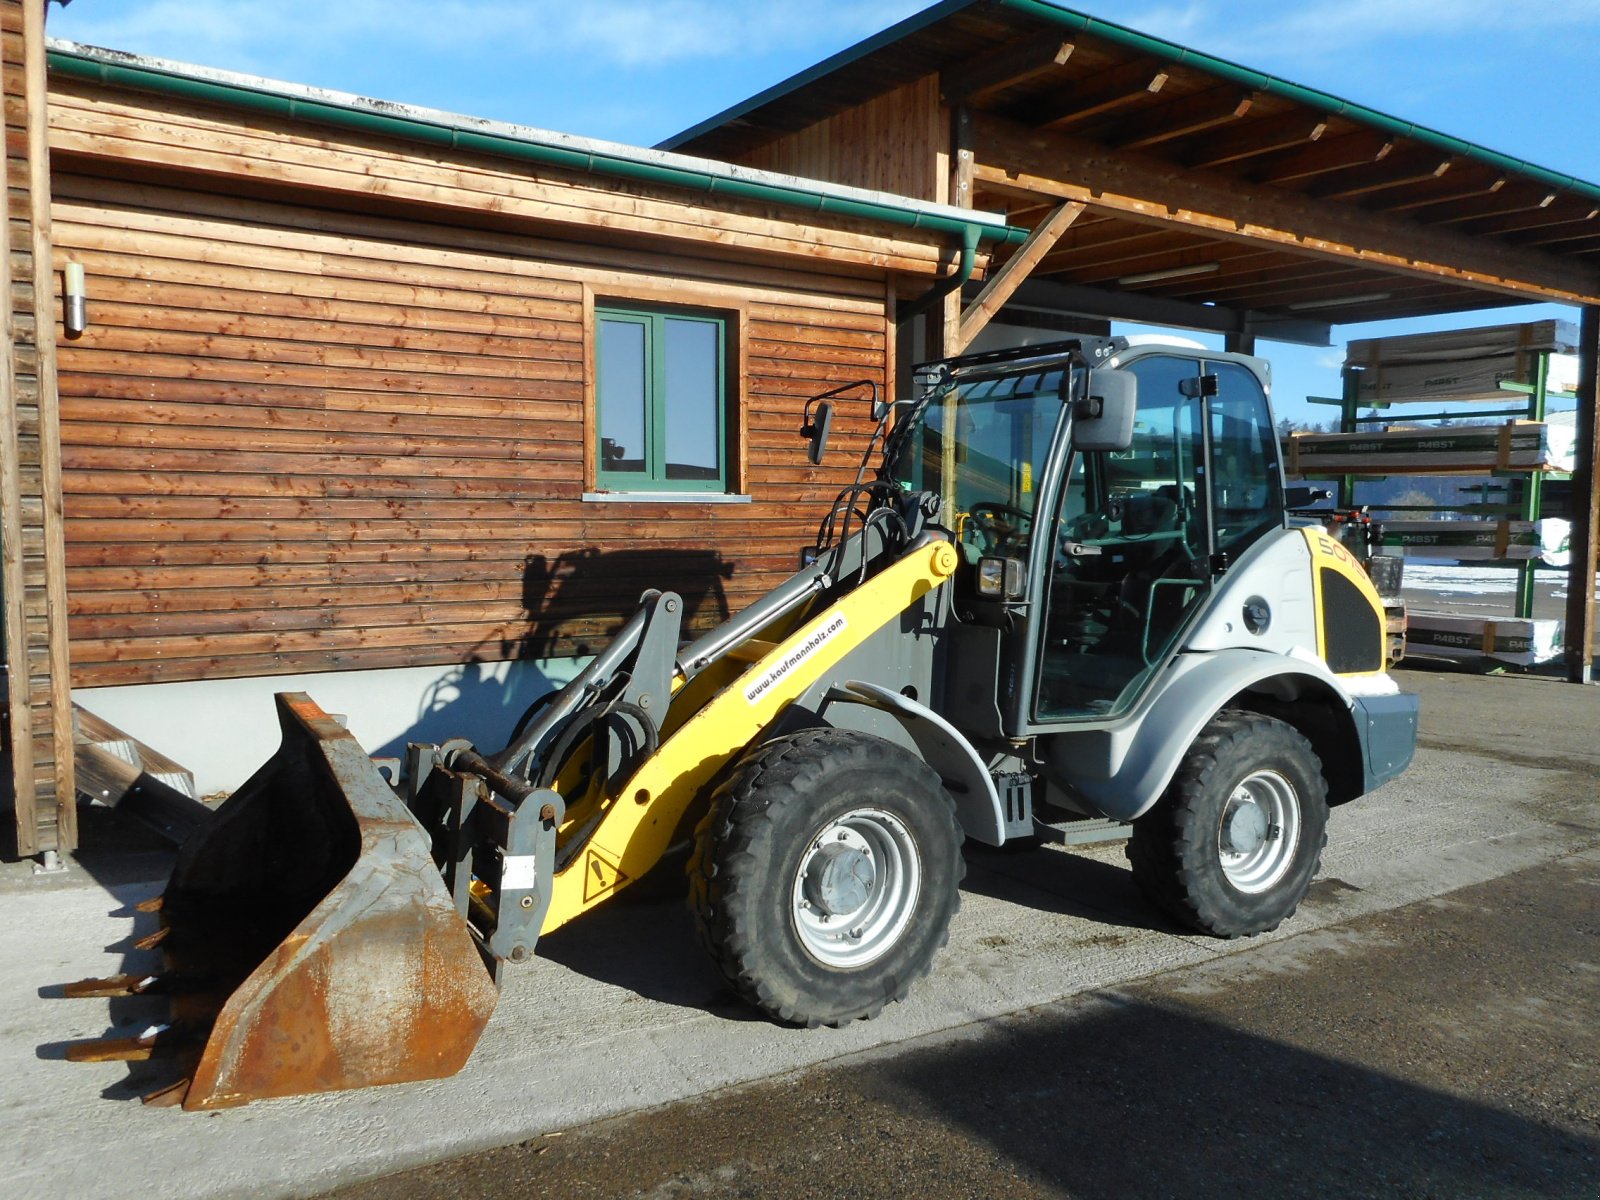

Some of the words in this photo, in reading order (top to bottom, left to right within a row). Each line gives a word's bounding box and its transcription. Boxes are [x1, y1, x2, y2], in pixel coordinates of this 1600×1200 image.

[1349, 442, 1384, 452] PABST
[1418, 440, 1456, 450] PABST
[1402, 535, 1439, 544] PABST
[1433, 633, 1472, 645] PABST
[747, 618, 844, 701] www.kaufmannholz.com
